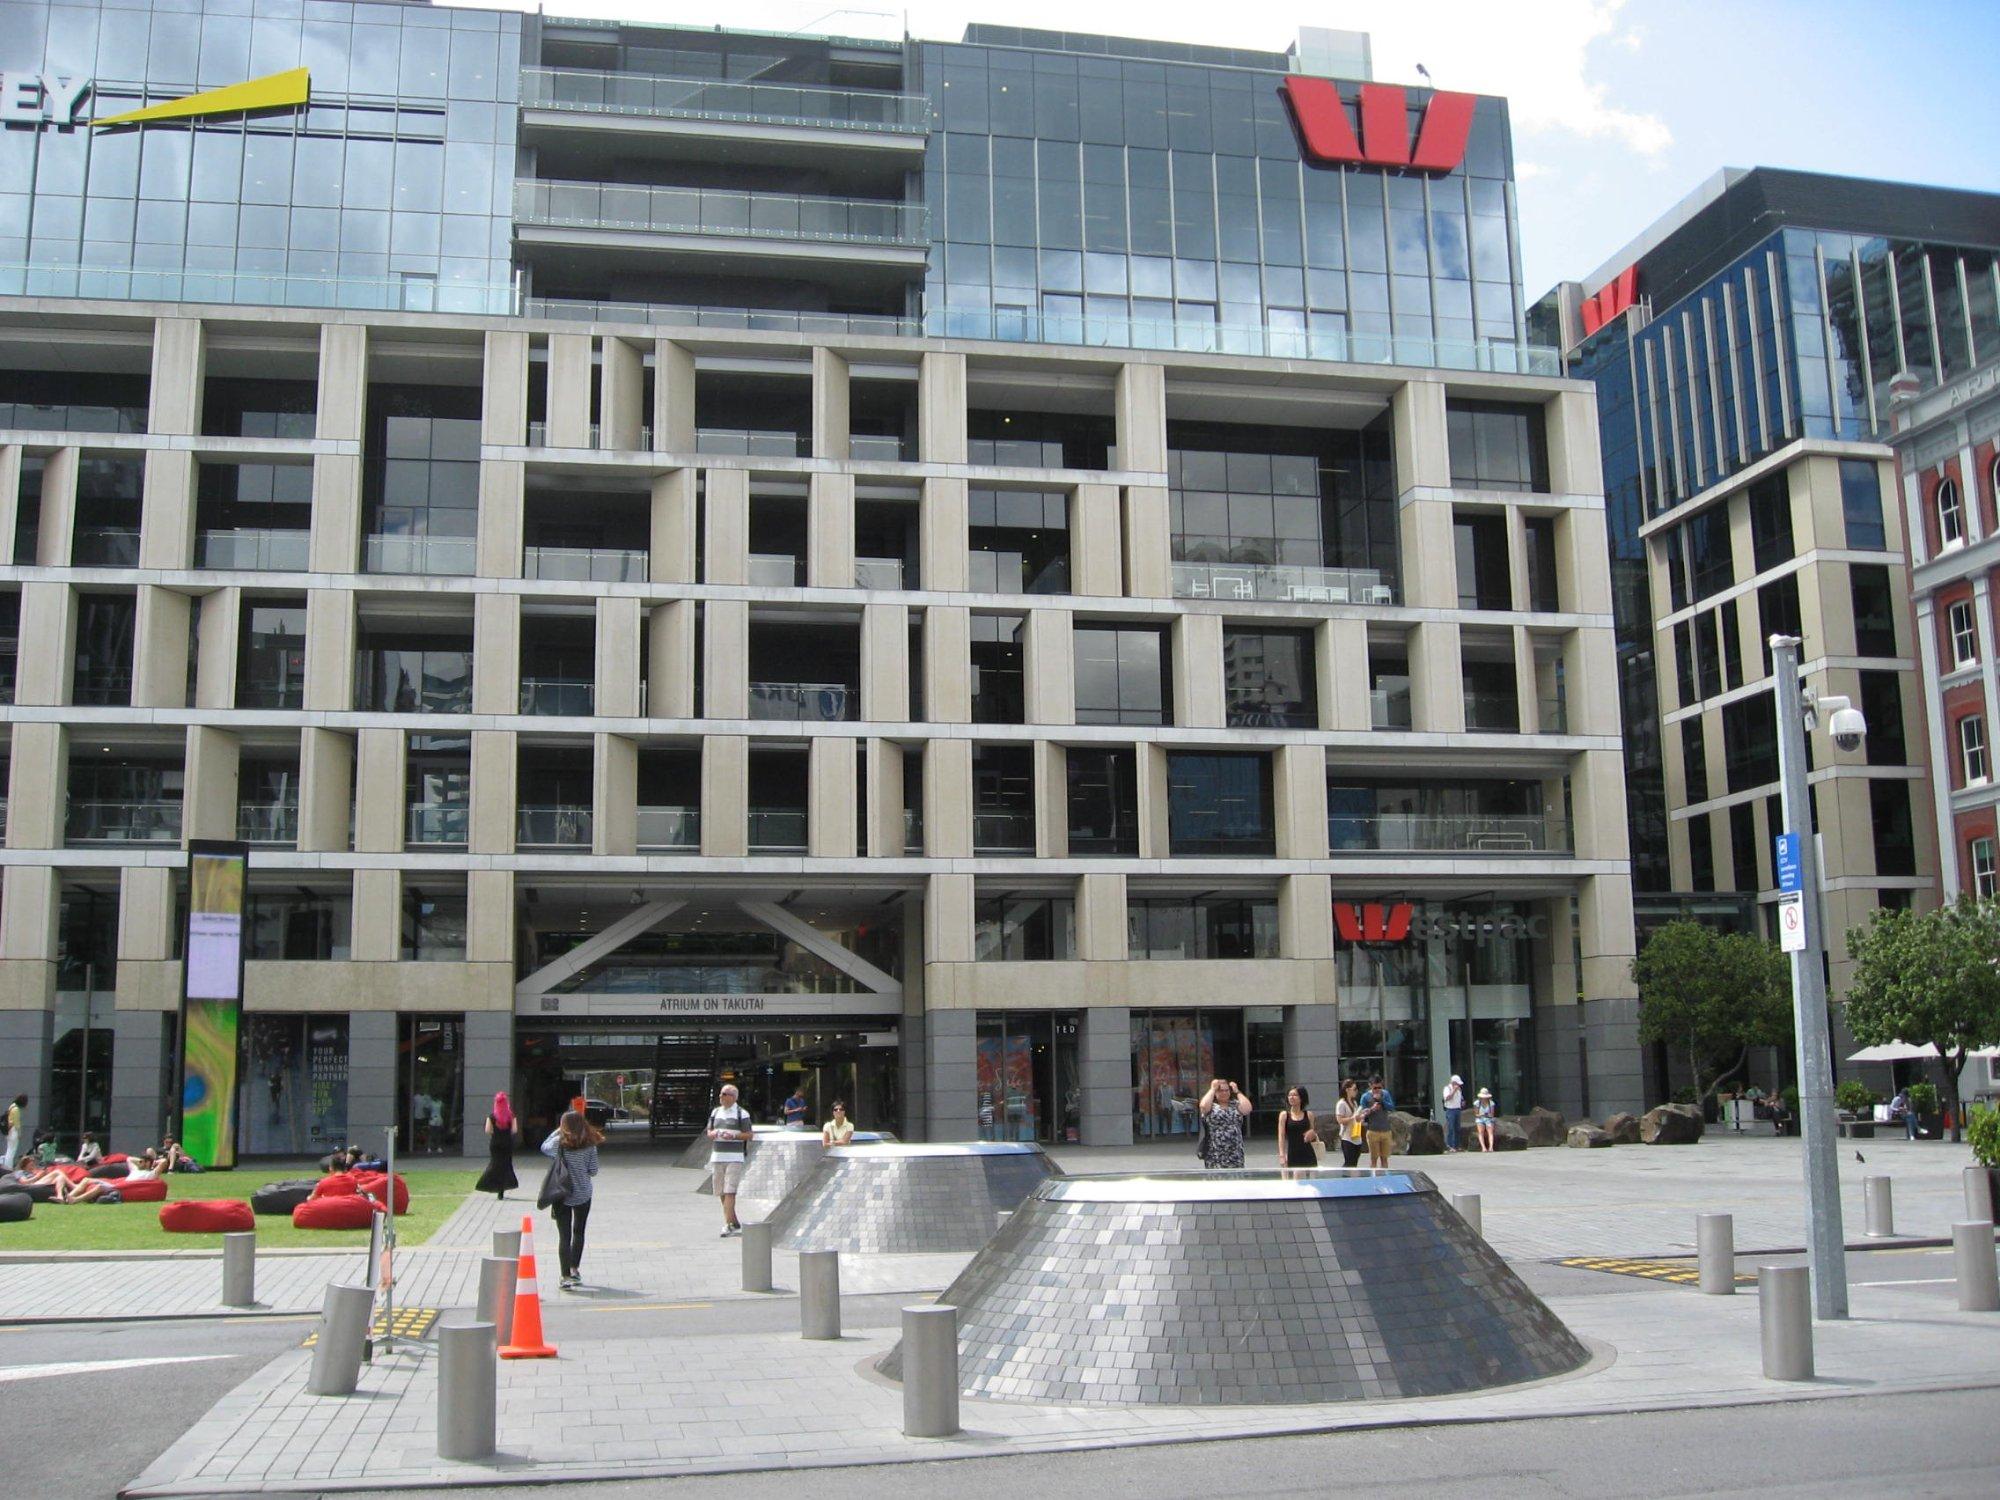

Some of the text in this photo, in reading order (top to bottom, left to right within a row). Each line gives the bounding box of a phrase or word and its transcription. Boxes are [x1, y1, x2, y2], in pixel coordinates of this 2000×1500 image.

[0, 72, 91, 123] EY
[1332, 903, 1548, 947] Westpac
[660, 998, 764, 1011] ATRIUM ON TAKUTAI
[1056, 1025, 1075, 1034] TED
[313, 1047, 334, 1055] YOUR
[312, 1055, 348, 1064] PERFECT
